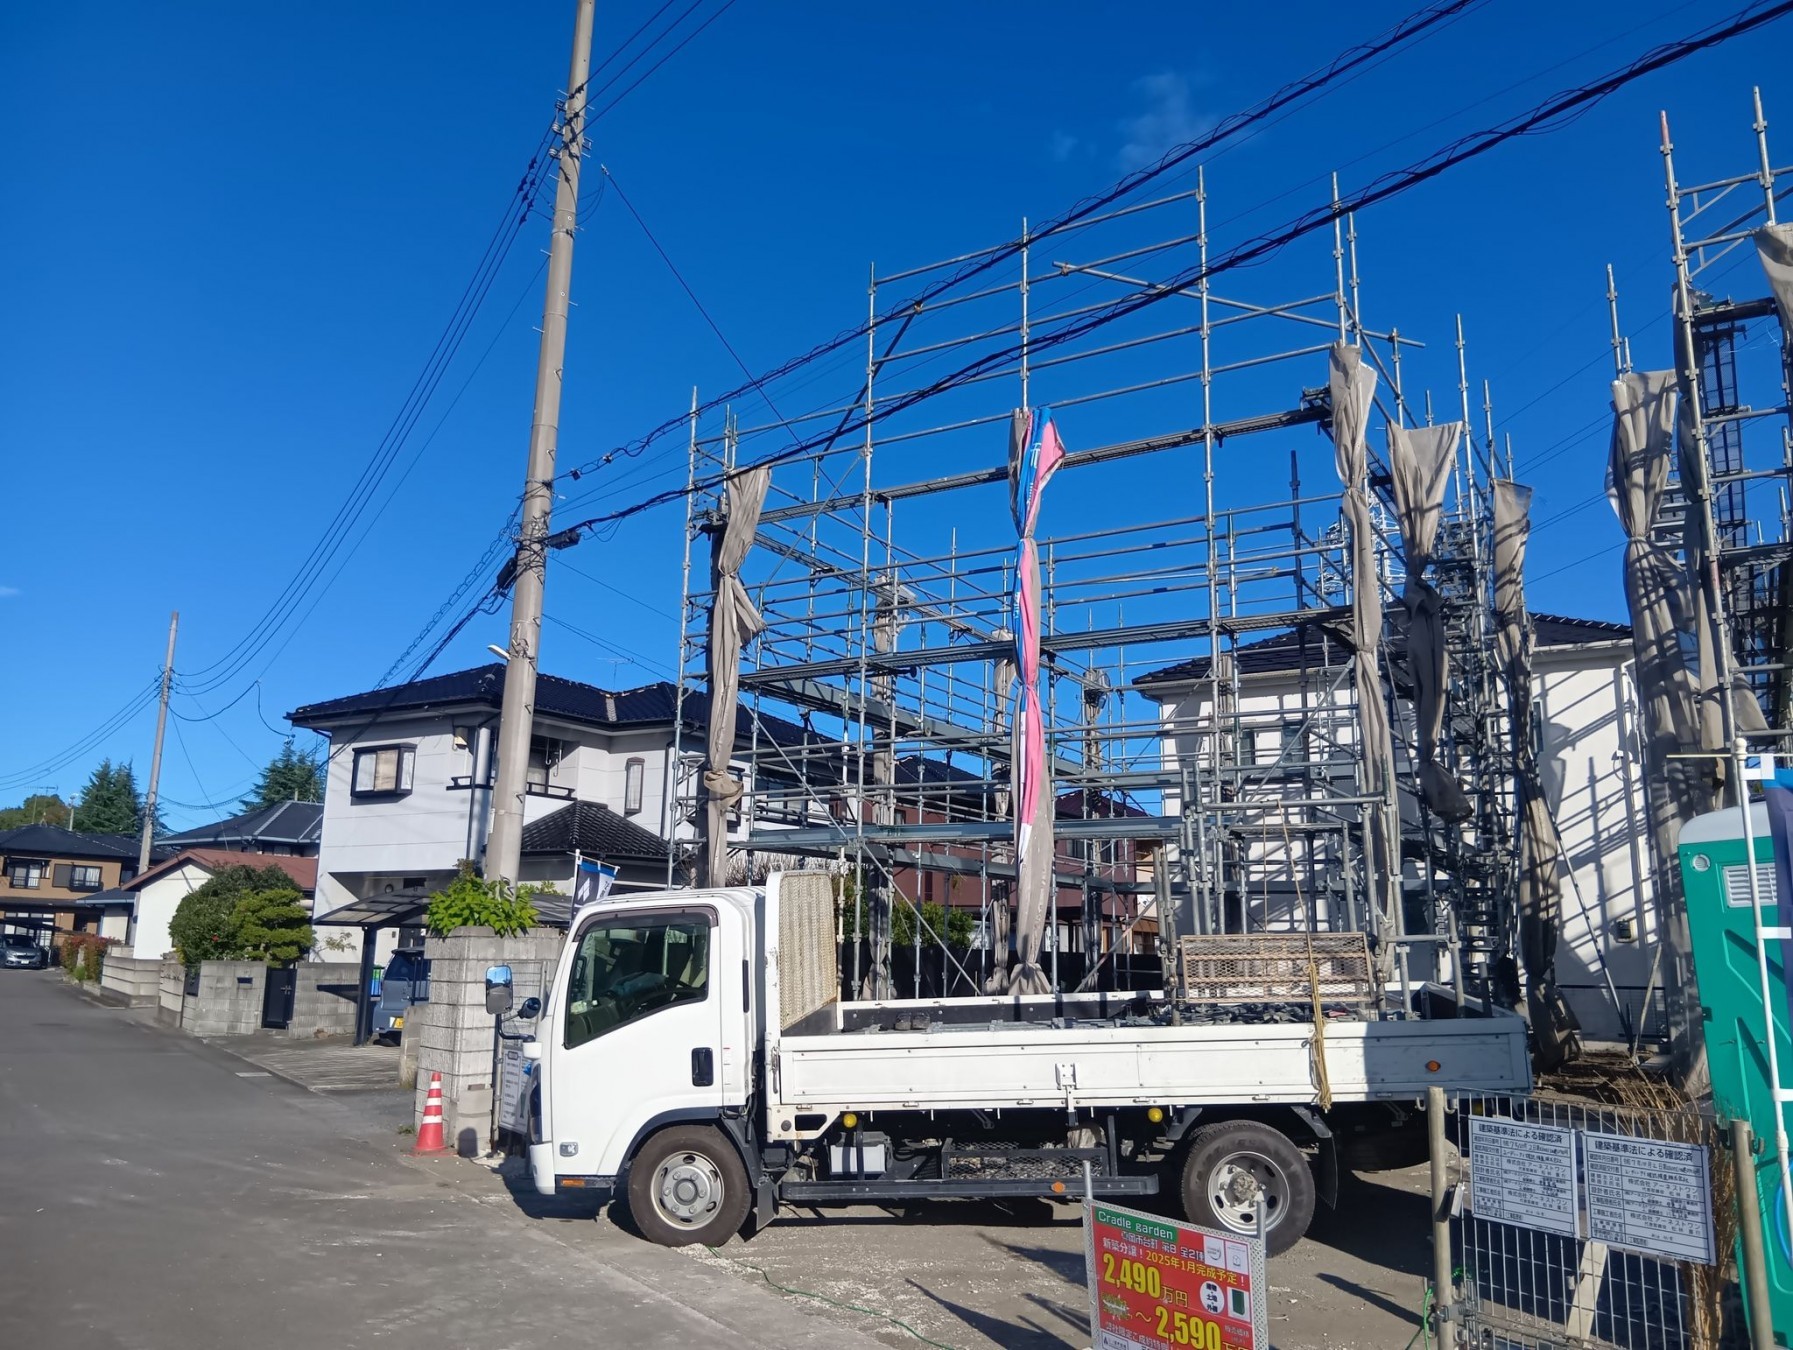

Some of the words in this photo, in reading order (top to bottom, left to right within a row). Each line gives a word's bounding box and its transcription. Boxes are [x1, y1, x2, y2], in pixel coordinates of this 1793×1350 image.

[1478, 1123, 1562, 1143] 建築基準法による確認済
[1595, 1140, 1693, 1162] 建築基準法による確認済
[1098, 1210, 1132, 1229] Cradle
[1135, 1222, 1173, 1240] garden
